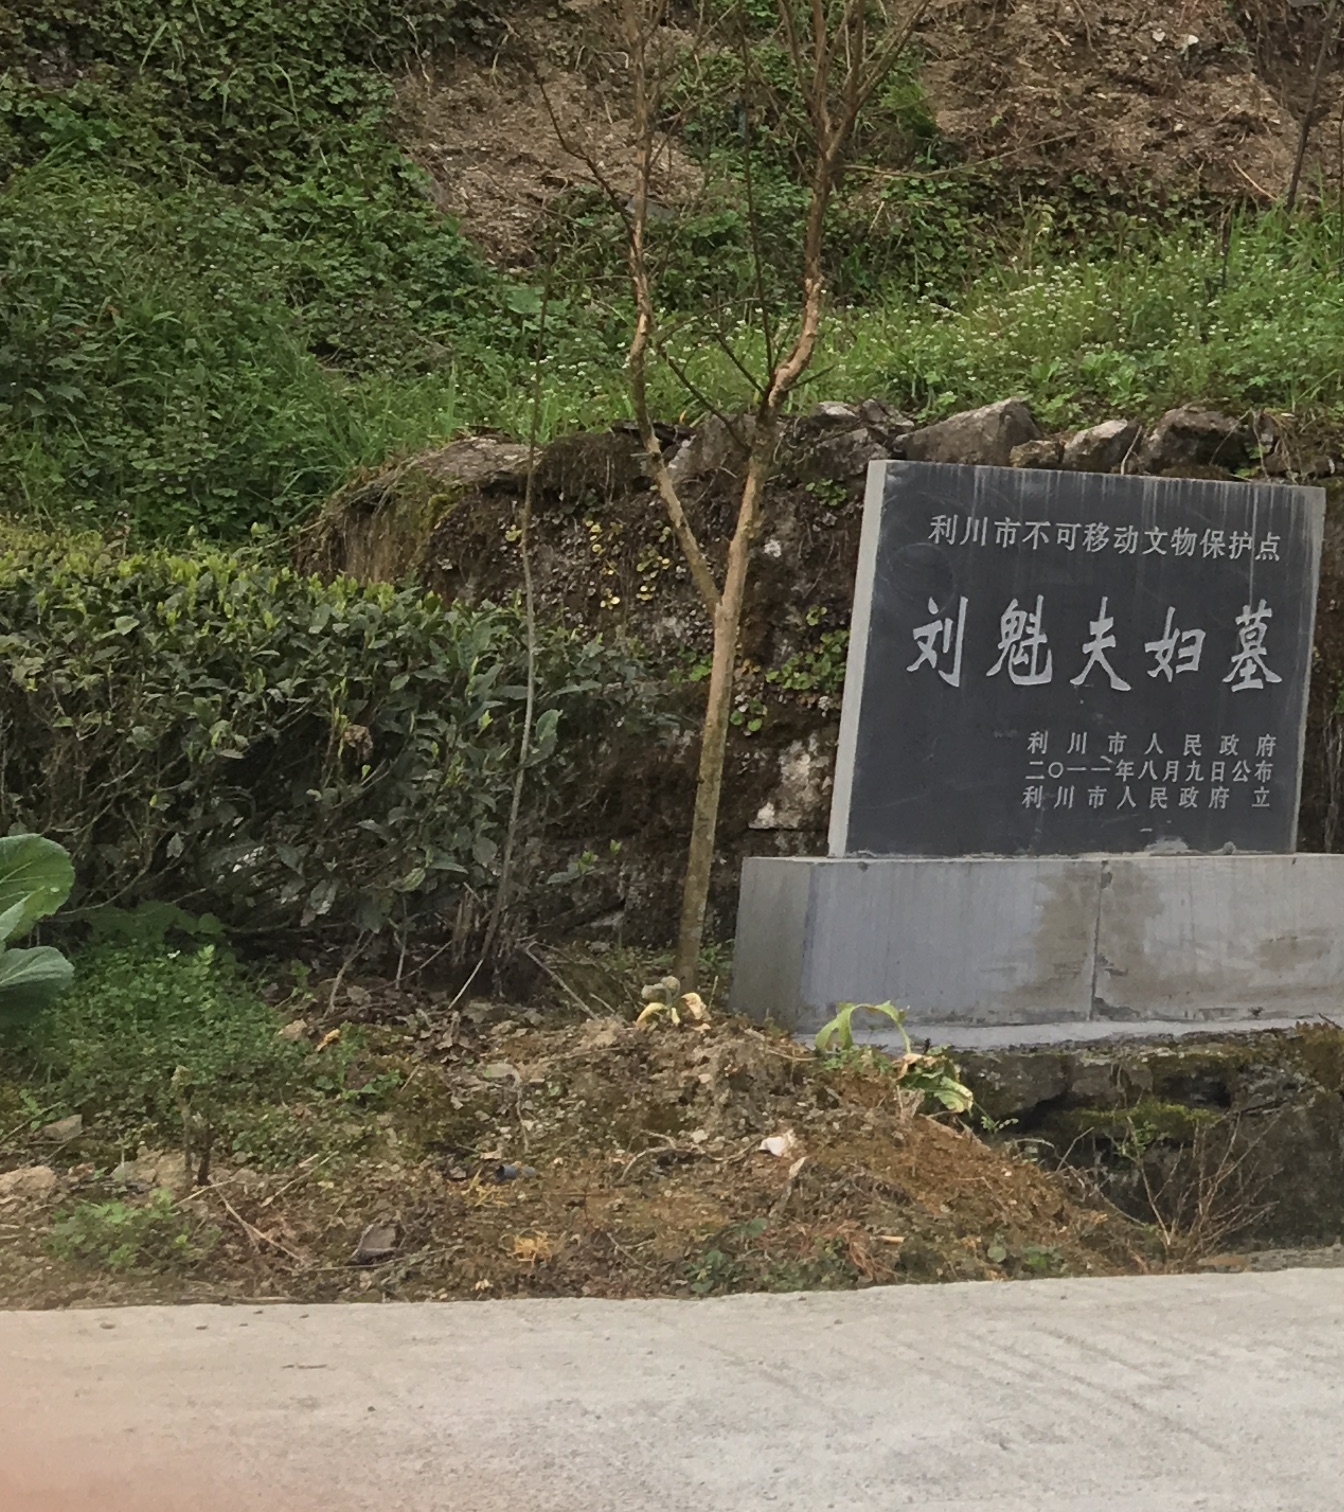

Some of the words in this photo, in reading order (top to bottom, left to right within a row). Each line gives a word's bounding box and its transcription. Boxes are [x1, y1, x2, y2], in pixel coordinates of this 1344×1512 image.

[928, 514, 1281, 562] 利川市不可移动文物保护点
[906, 596, 1283, 692] 刘魁夫妇墓
[1027, 731, 1277, 757] 利川市人民政府
